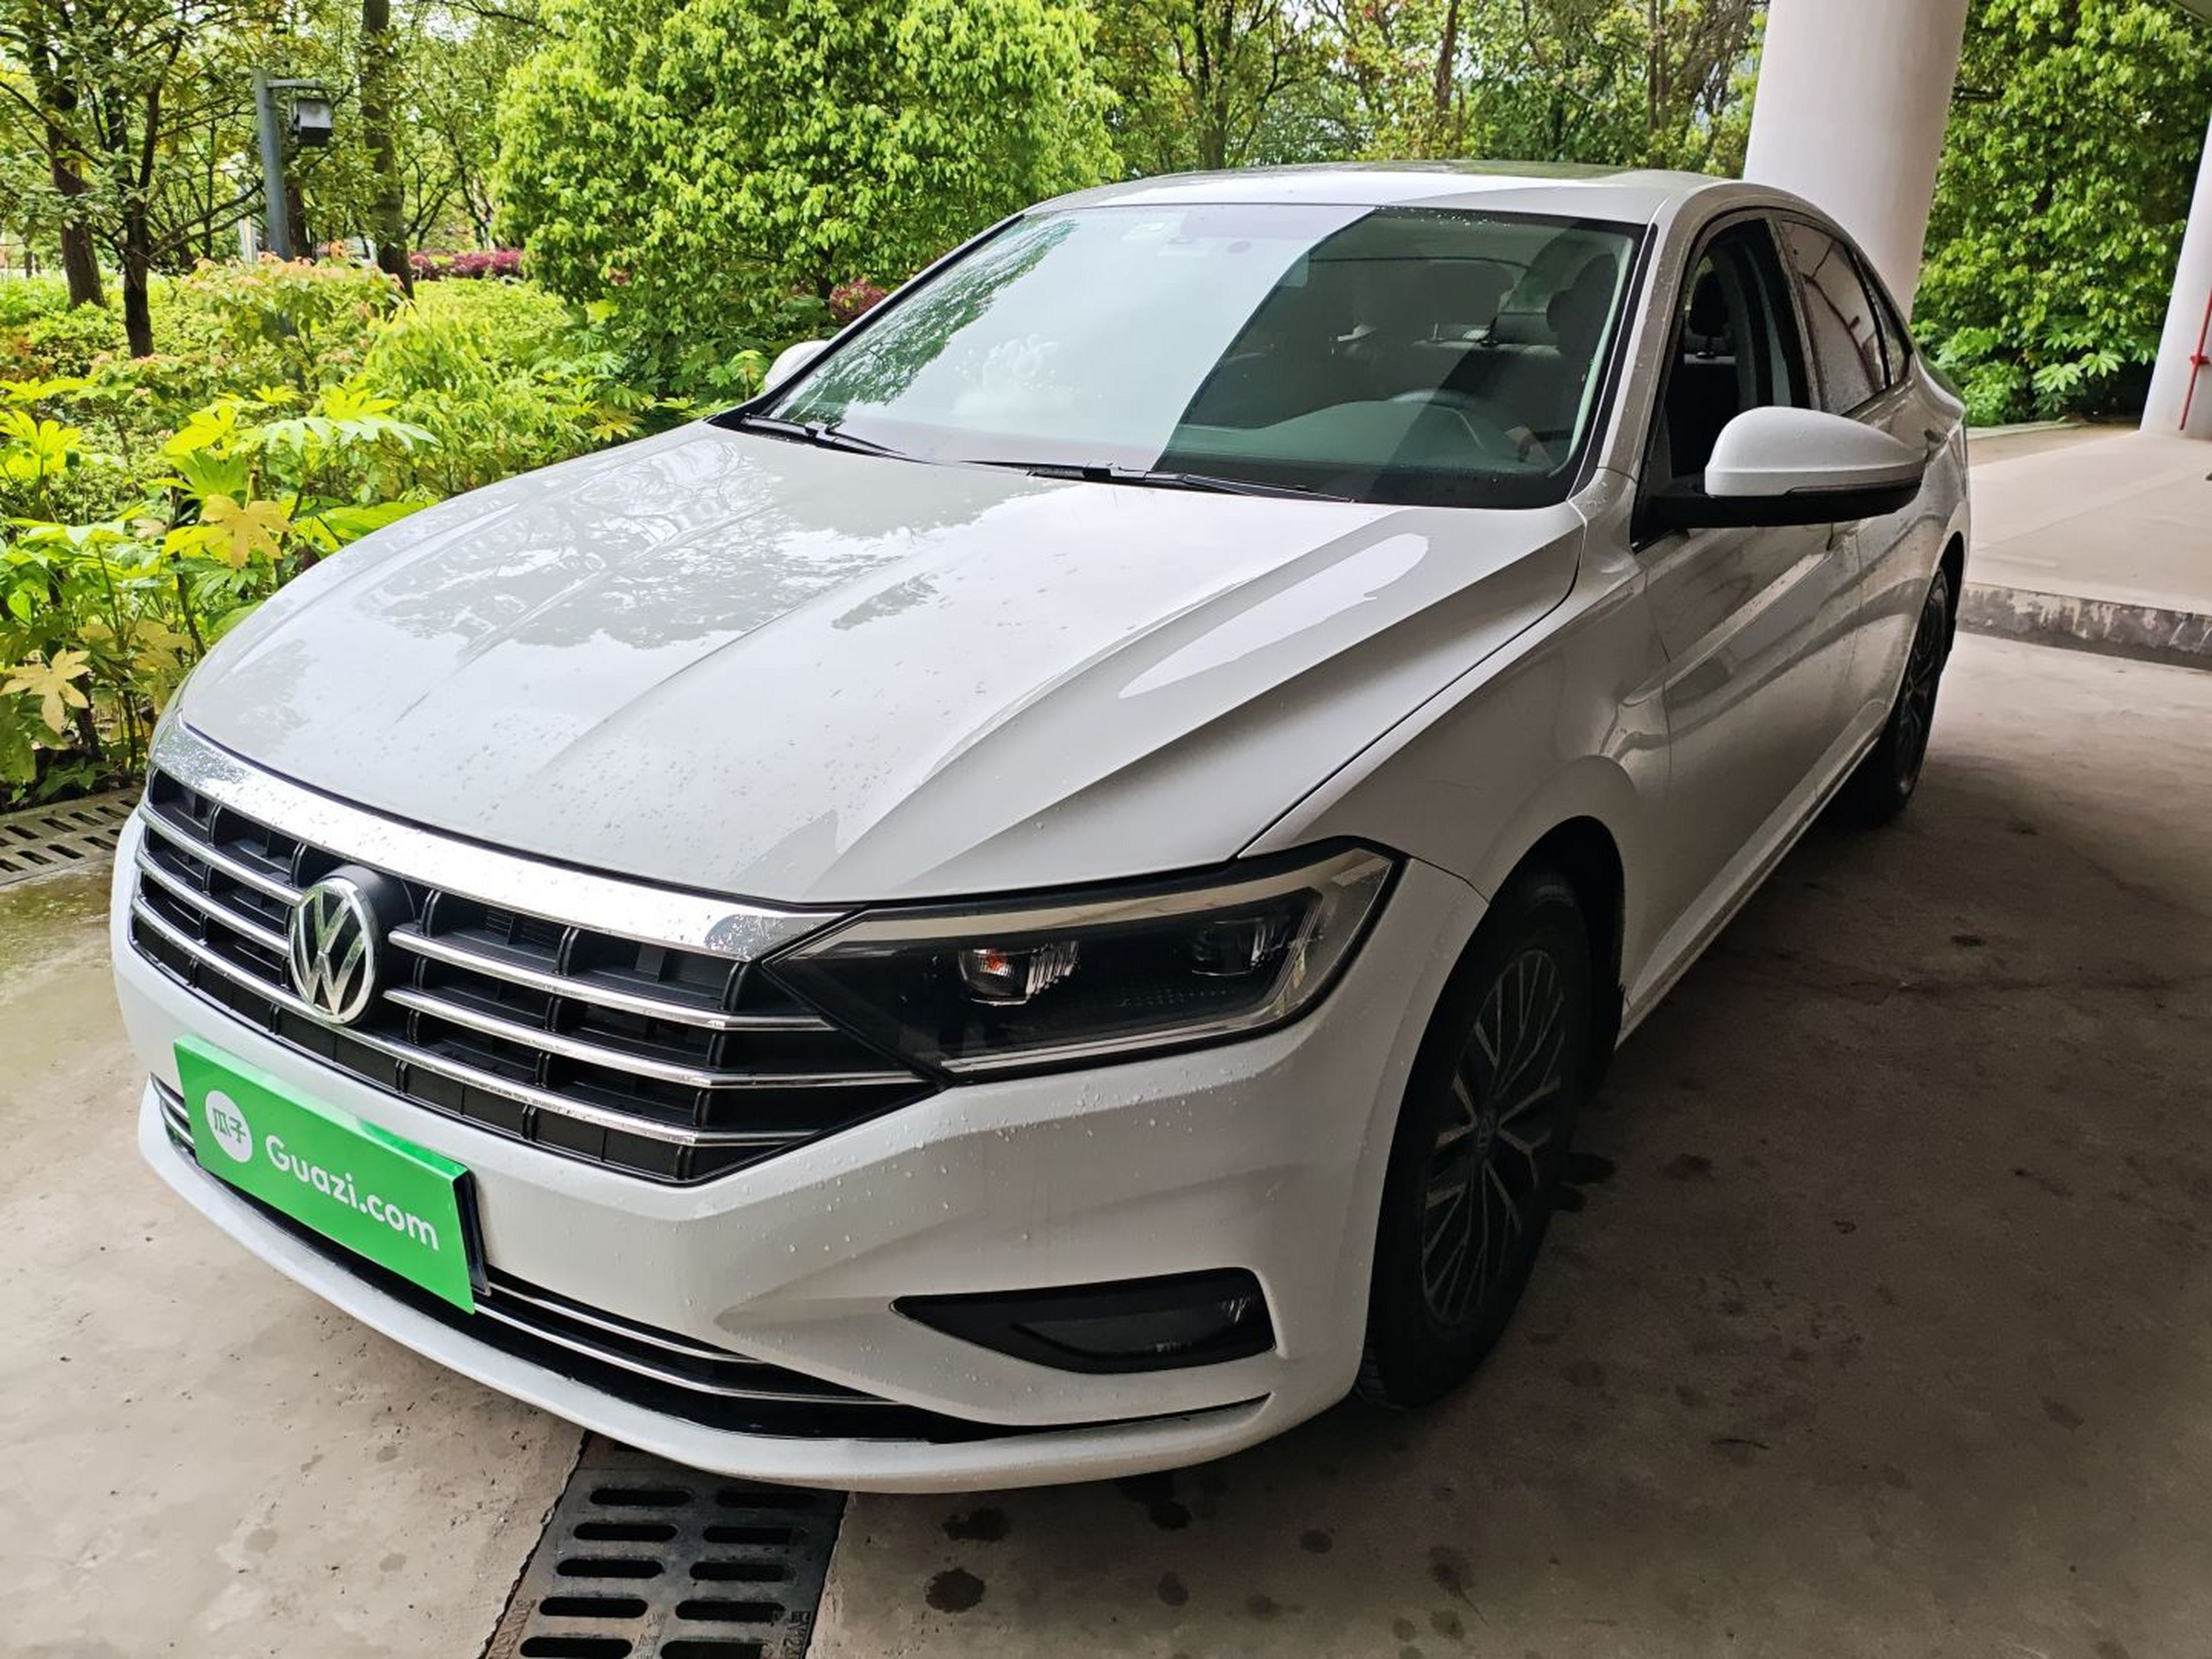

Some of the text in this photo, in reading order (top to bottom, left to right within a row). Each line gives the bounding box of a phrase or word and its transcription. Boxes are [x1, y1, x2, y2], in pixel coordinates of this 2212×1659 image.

[293, 884, 369, 1018] VW
[212, 1107, 247, 1143] 瓜子
[265, 1134, 439, 1251] Guazi.com
